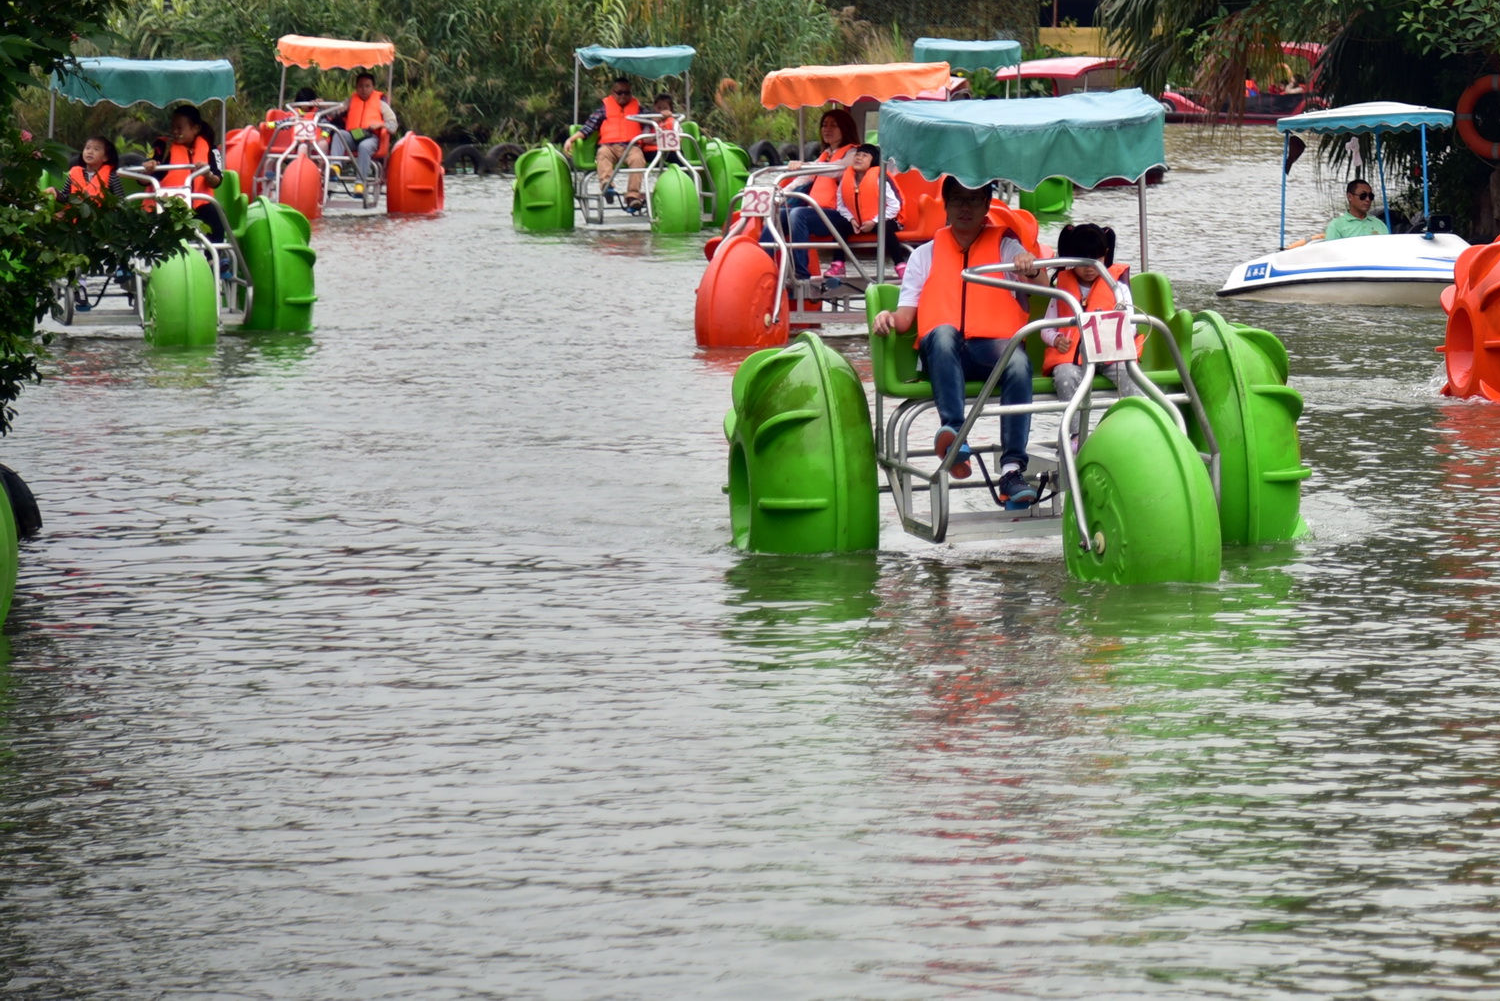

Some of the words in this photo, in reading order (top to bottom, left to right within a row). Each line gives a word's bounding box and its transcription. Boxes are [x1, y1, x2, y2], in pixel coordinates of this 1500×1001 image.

[296, 122, 316, 137] 29
[661, 132, 679, 148] 13
[741, 190, 771, 214] 28
[1082, 311, 1126, 354] 17
